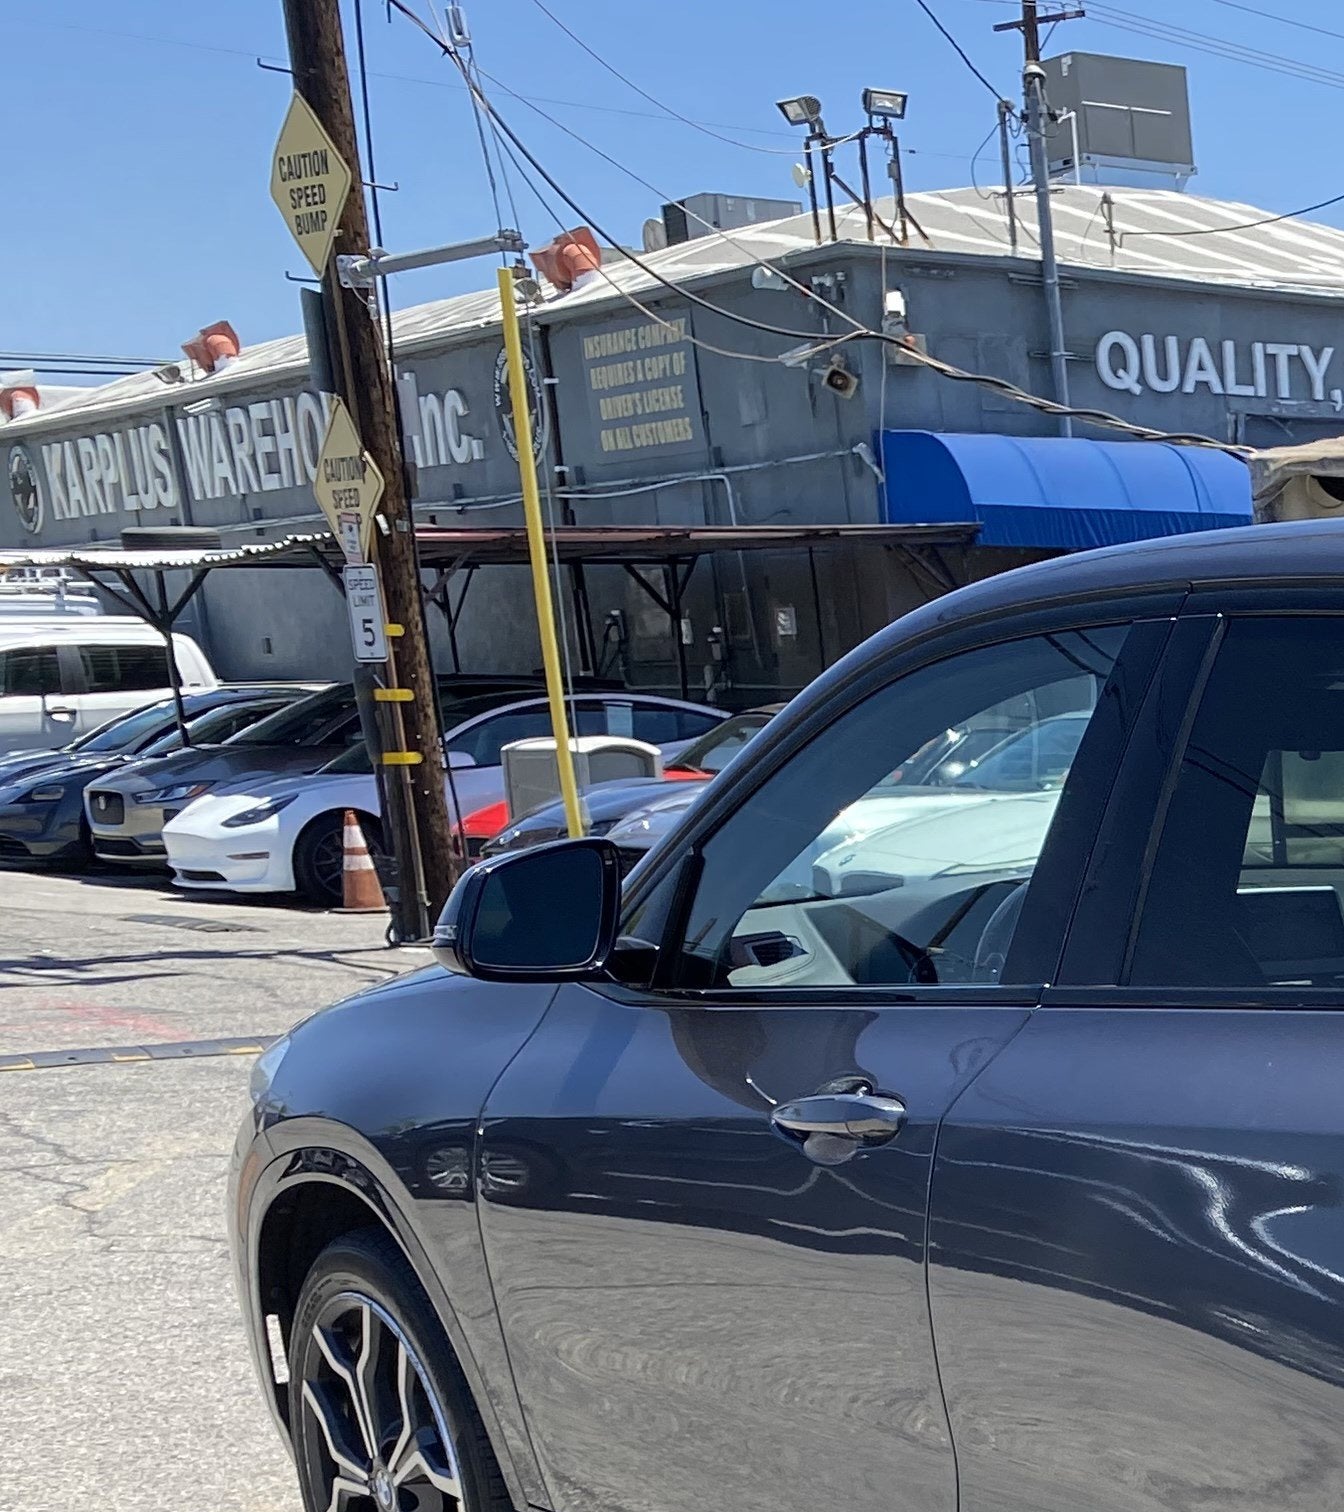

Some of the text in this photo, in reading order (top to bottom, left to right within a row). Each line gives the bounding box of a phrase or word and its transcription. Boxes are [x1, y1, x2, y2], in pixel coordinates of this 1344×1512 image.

[278, 149, 329, 182] CAUTION
[289, 184, 326, 209] SPEED
[295, 210, 327, 235] BUMP
[584, 328, 637, 359] INSURANCE
[590, 351, 685, 390] REQUIRES A COPY OF
[1096, 330, 1343, 412] QUALITY,
[600, 385, 684, 420] DRIVER'S LICENSE
[601, 429, 616, 452] ON
[632, 417, 693, 448] CUSTOMERS
[42, 423, 178, 520] KARPLUS
[176, 391, 338, 500] WAREHO
[332, 487, 360, 509] SPEED
[362, 618, 376, 647] 5
